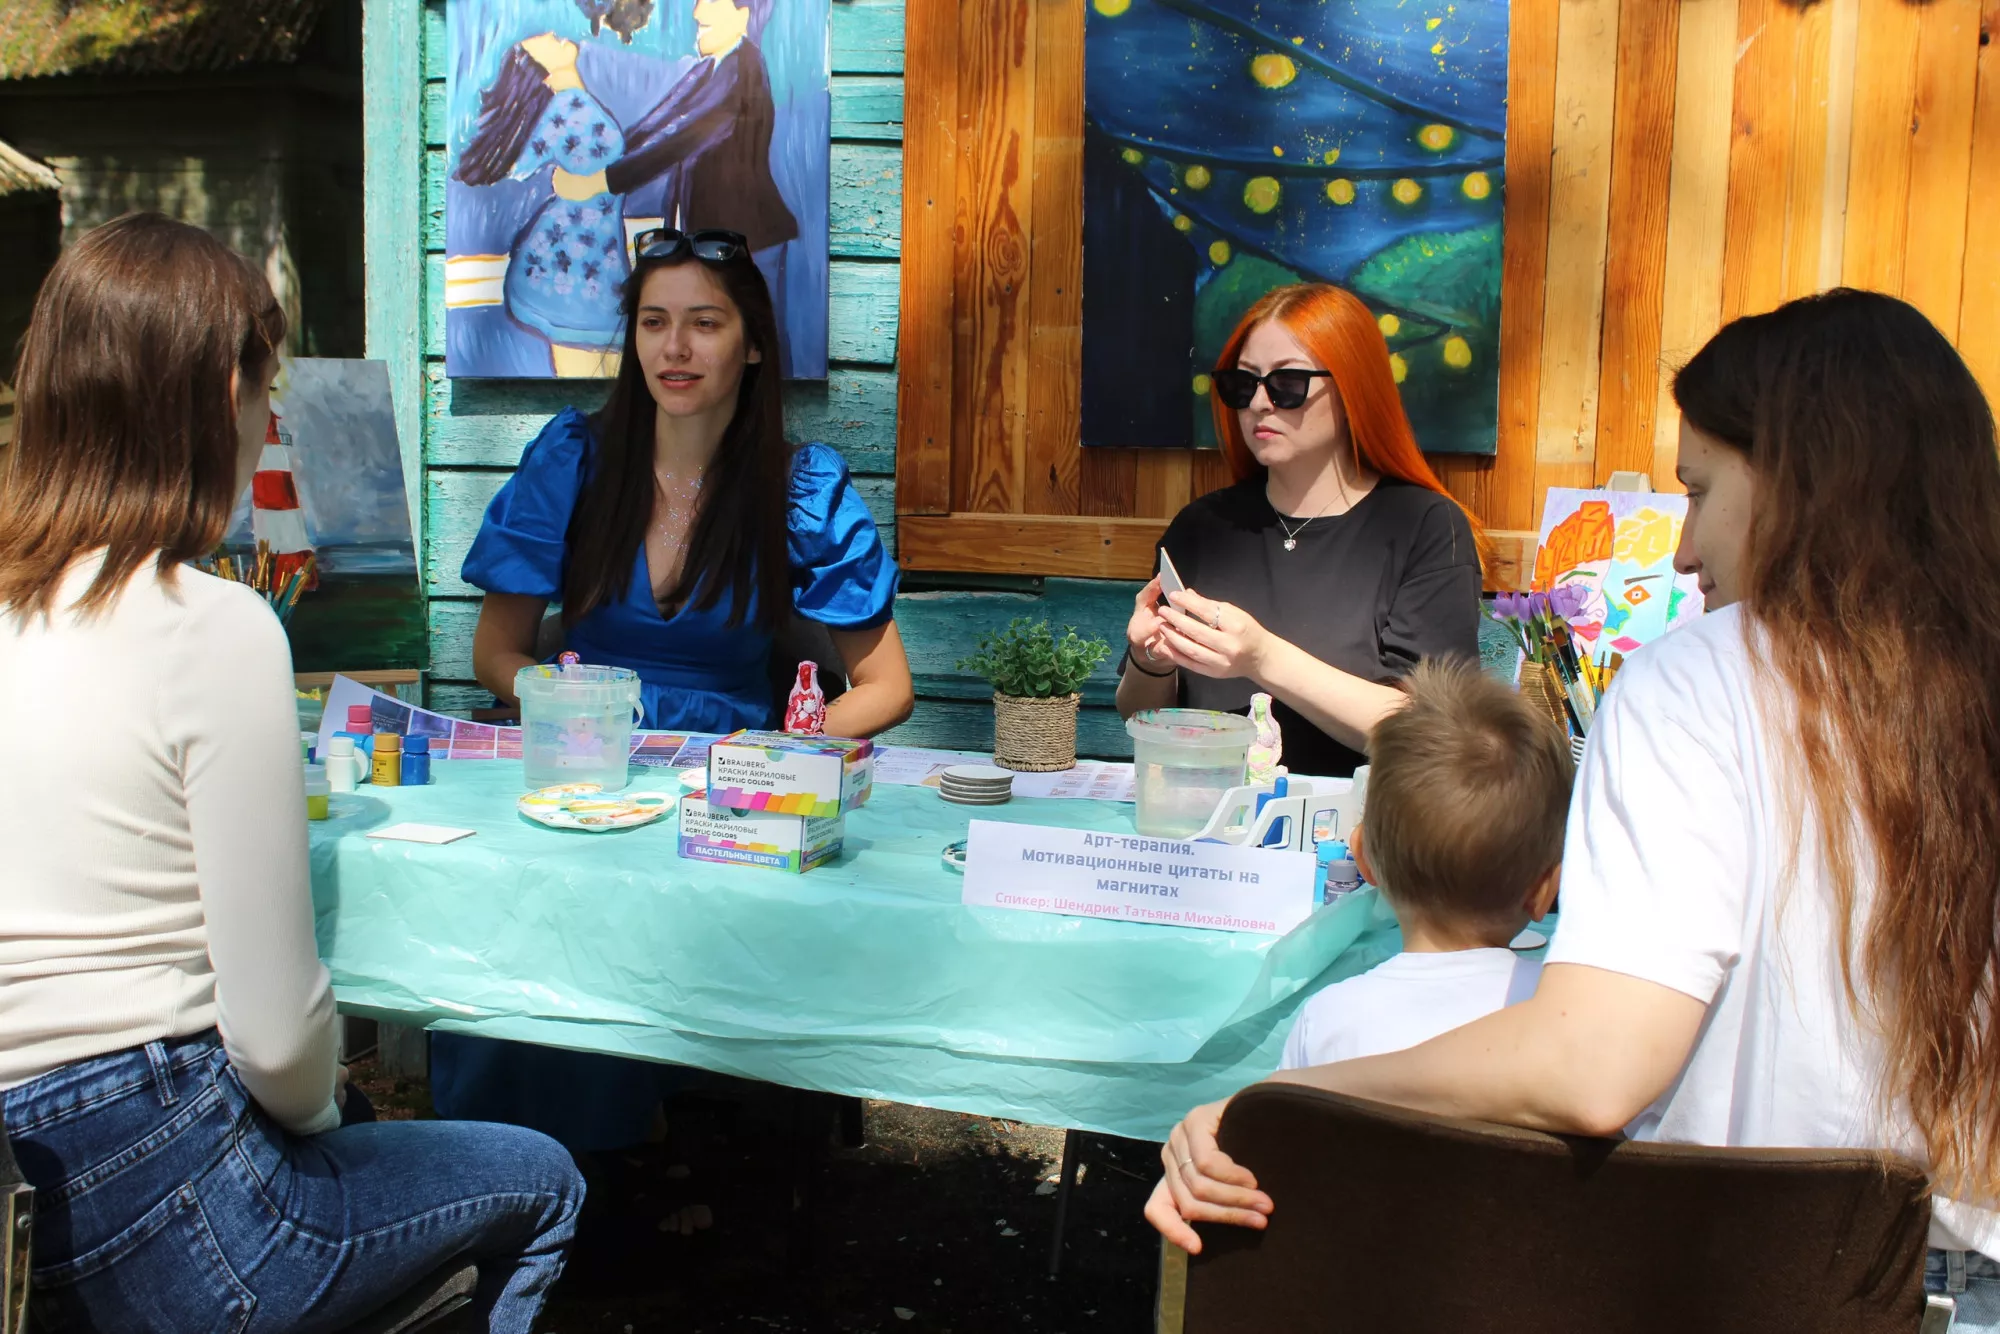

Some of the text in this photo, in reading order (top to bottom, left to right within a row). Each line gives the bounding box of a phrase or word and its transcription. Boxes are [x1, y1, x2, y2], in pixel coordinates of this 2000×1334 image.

[726, 759, 766, 769] BRAUBERG
[718, 767, 797, 782] КРАСКИ АКРИЛОВЫЕ
[718, 776, 775, 787] ACRYLIC COLORS
[693, 810, 730, 822] BRAUBERG
[685, 819, 758, 835] КРАСКИ АКРИЛОВЫЕ
[685, 827, 738, 840] ACRYLIC COLORS
[1083, 833, 1195, 856] Арт-терапия.
[695, 846, 781, 866] ПАСТЕЛЬНЫЕ ЦВЕТА
[1022, 848, 1260, 884] Мотивационные цитаты на
[1096, 878, 1179, 898] магнитах
[995, 892, 1276, 931] Спикер: Шендрик Татьяна Михайловна
